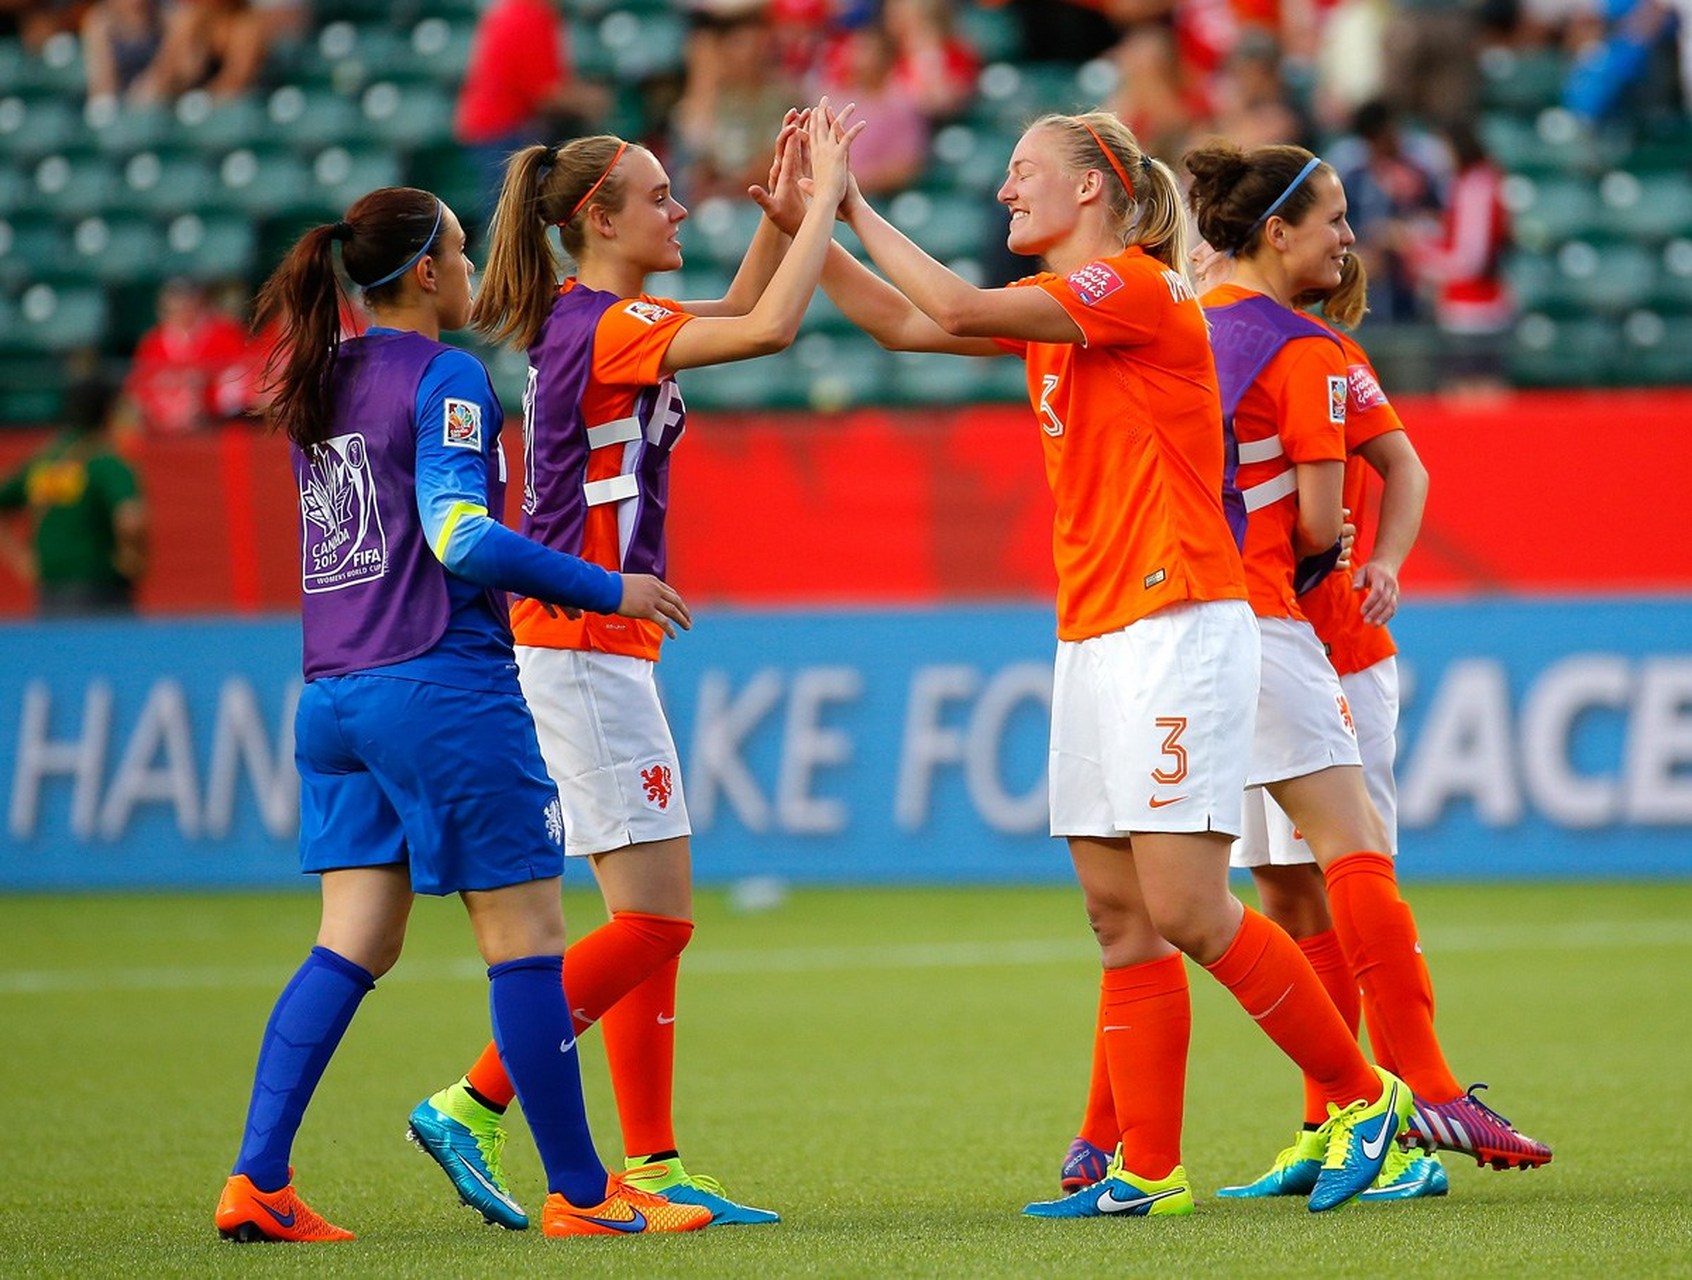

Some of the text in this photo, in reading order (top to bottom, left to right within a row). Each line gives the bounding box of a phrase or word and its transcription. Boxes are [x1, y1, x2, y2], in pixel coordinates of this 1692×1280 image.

[1070, 273, 1104, 298] GOALS
[1080, 270, 1108, 291] YOUR
[1041, 374, 1064, 438] 3
[314, 550, 338, 570] 2015
[353, 548, 381, 567] FIFA
[8, 655, 1692, 842] HAN KE FO ACE
[1150, 716, 1188, 785] 3
